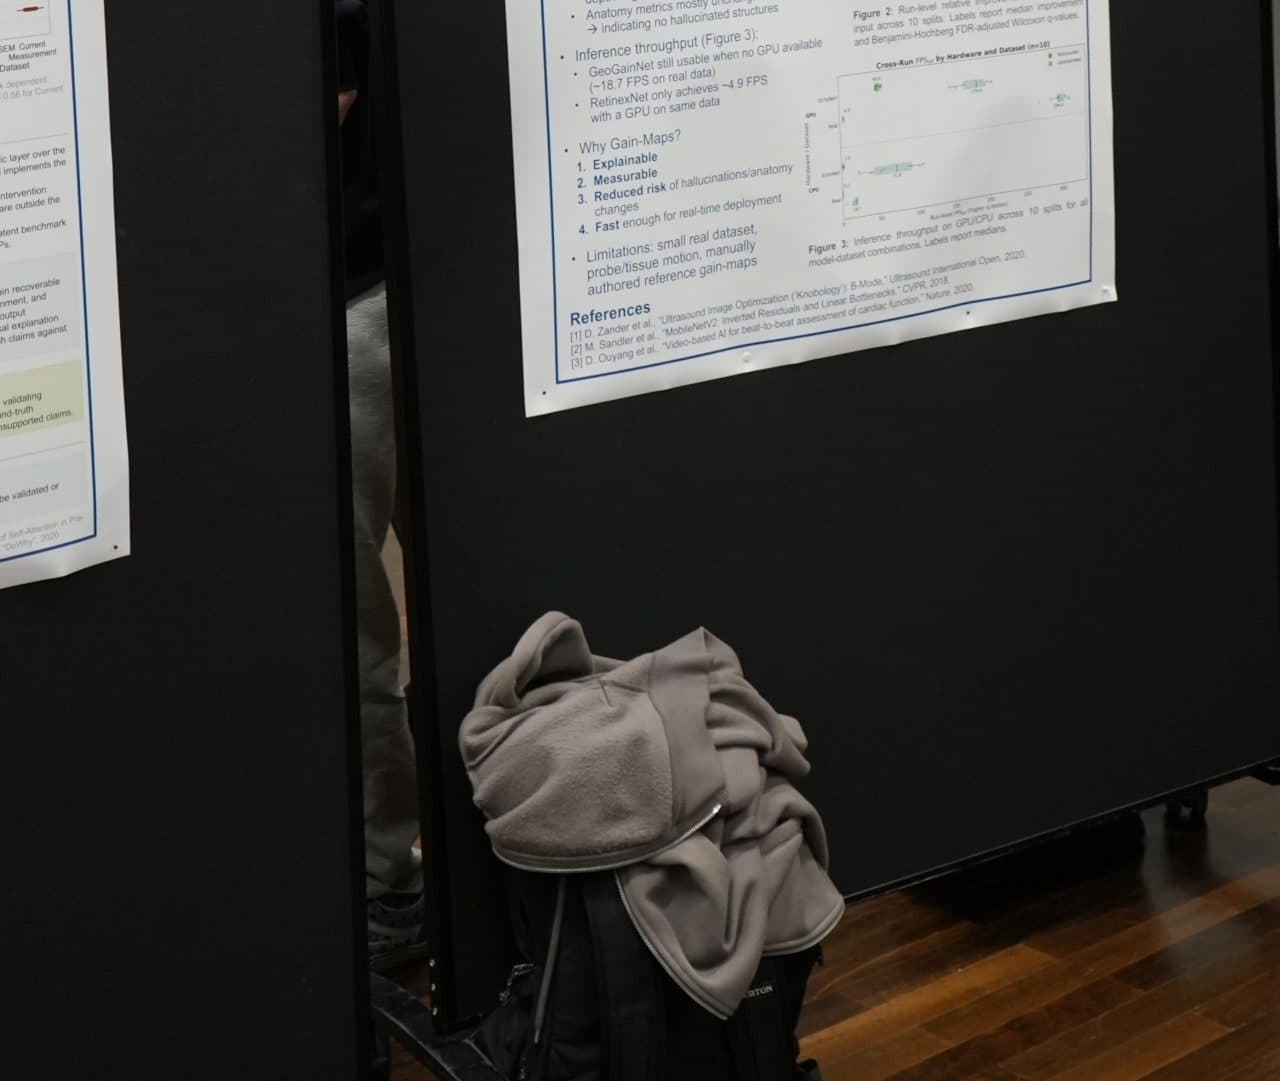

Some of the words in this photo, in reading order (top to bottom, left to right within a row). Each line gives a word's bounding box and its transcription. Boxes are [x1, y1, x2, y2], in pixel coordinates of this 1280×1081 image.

[578, 140, 607, 155] Why
[610, 128, 681, 150] Gain-Maps?
[593, 152, 658, 171] Explainable
[576, 177, 587, 189] 2.
[593, 168, 658, 186] Measurable
[808, 243, 836, 255] Figure
[570, 303, 651, 326] References
